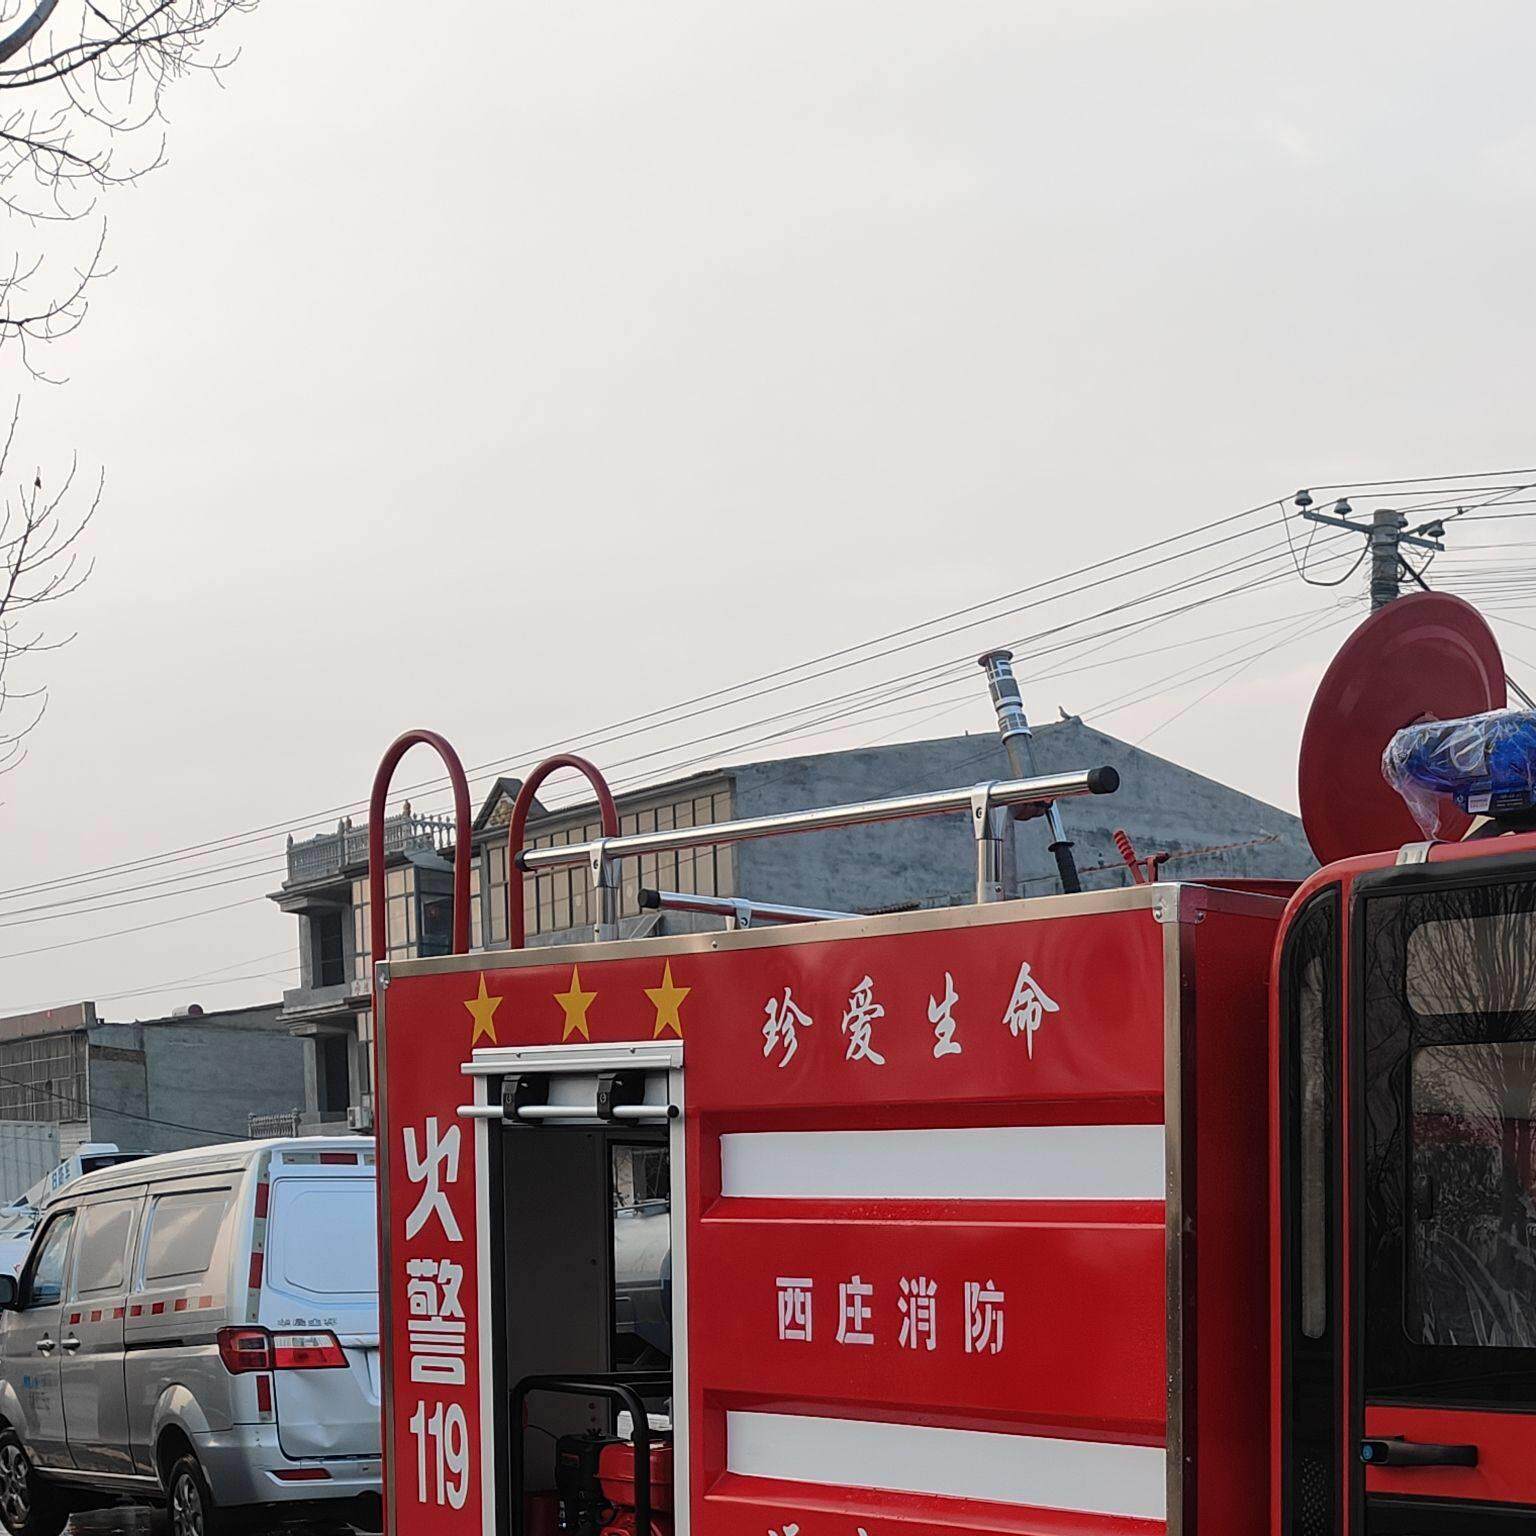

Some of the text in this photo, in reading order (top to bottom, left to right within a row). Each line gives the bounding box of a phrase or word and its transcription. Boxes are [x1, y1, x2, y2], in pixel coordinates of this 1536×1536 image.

[761, 961, 1060, 1068] 珍爱生命
[775, 1274, 1006, 1355] 西庄消防
